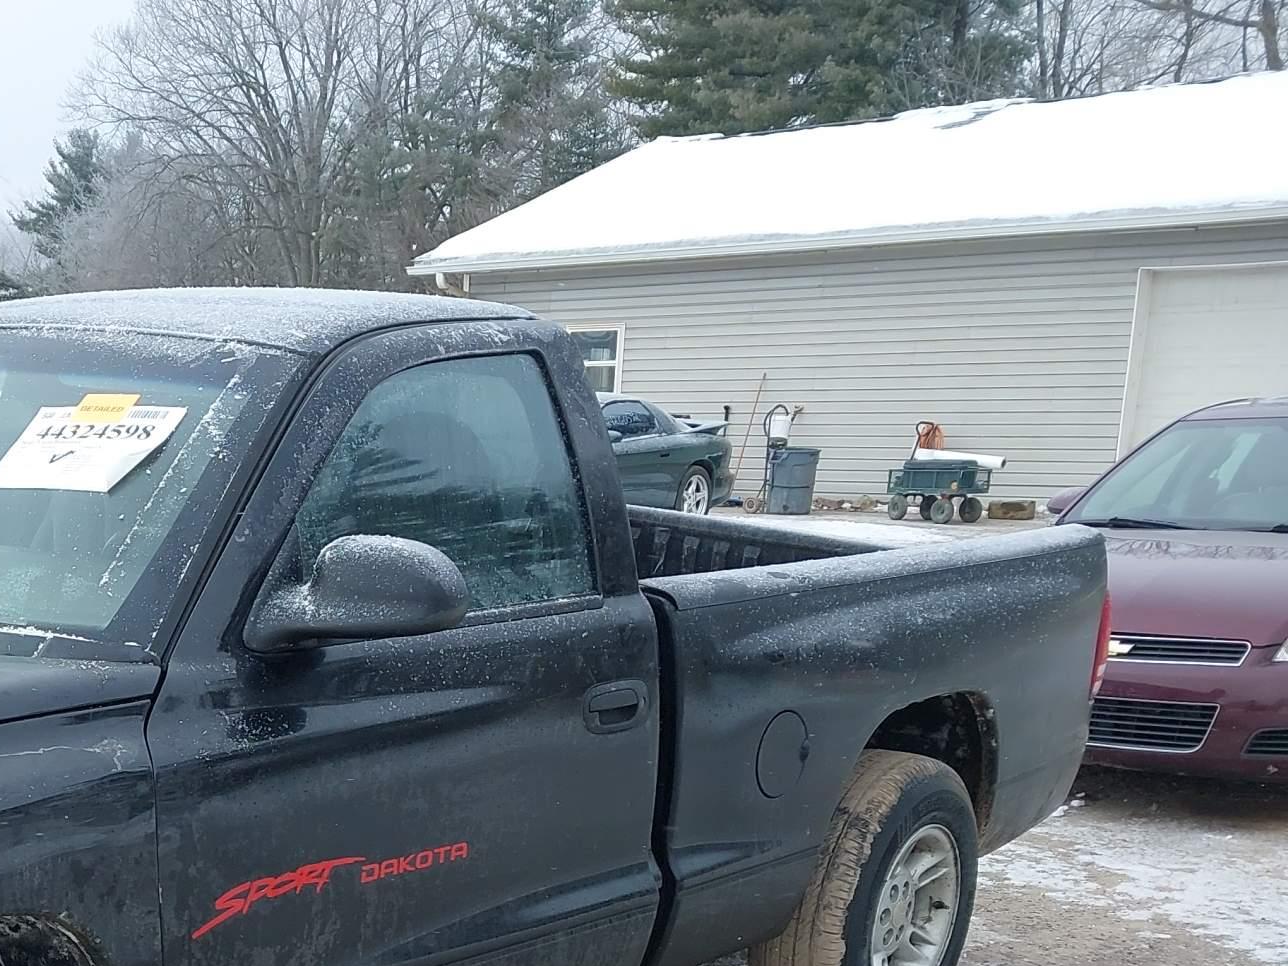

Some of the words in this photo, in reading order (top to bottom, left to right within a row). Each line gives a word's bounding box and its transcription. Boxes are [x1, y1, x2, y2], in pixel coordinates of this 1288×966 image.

[79, 405, 126, 413] DETAILED
[35, 424, 157, 441] 44324598
[192, 856, 367, 939] SPORT
[360, 841, 469, 883] DAKOTA
